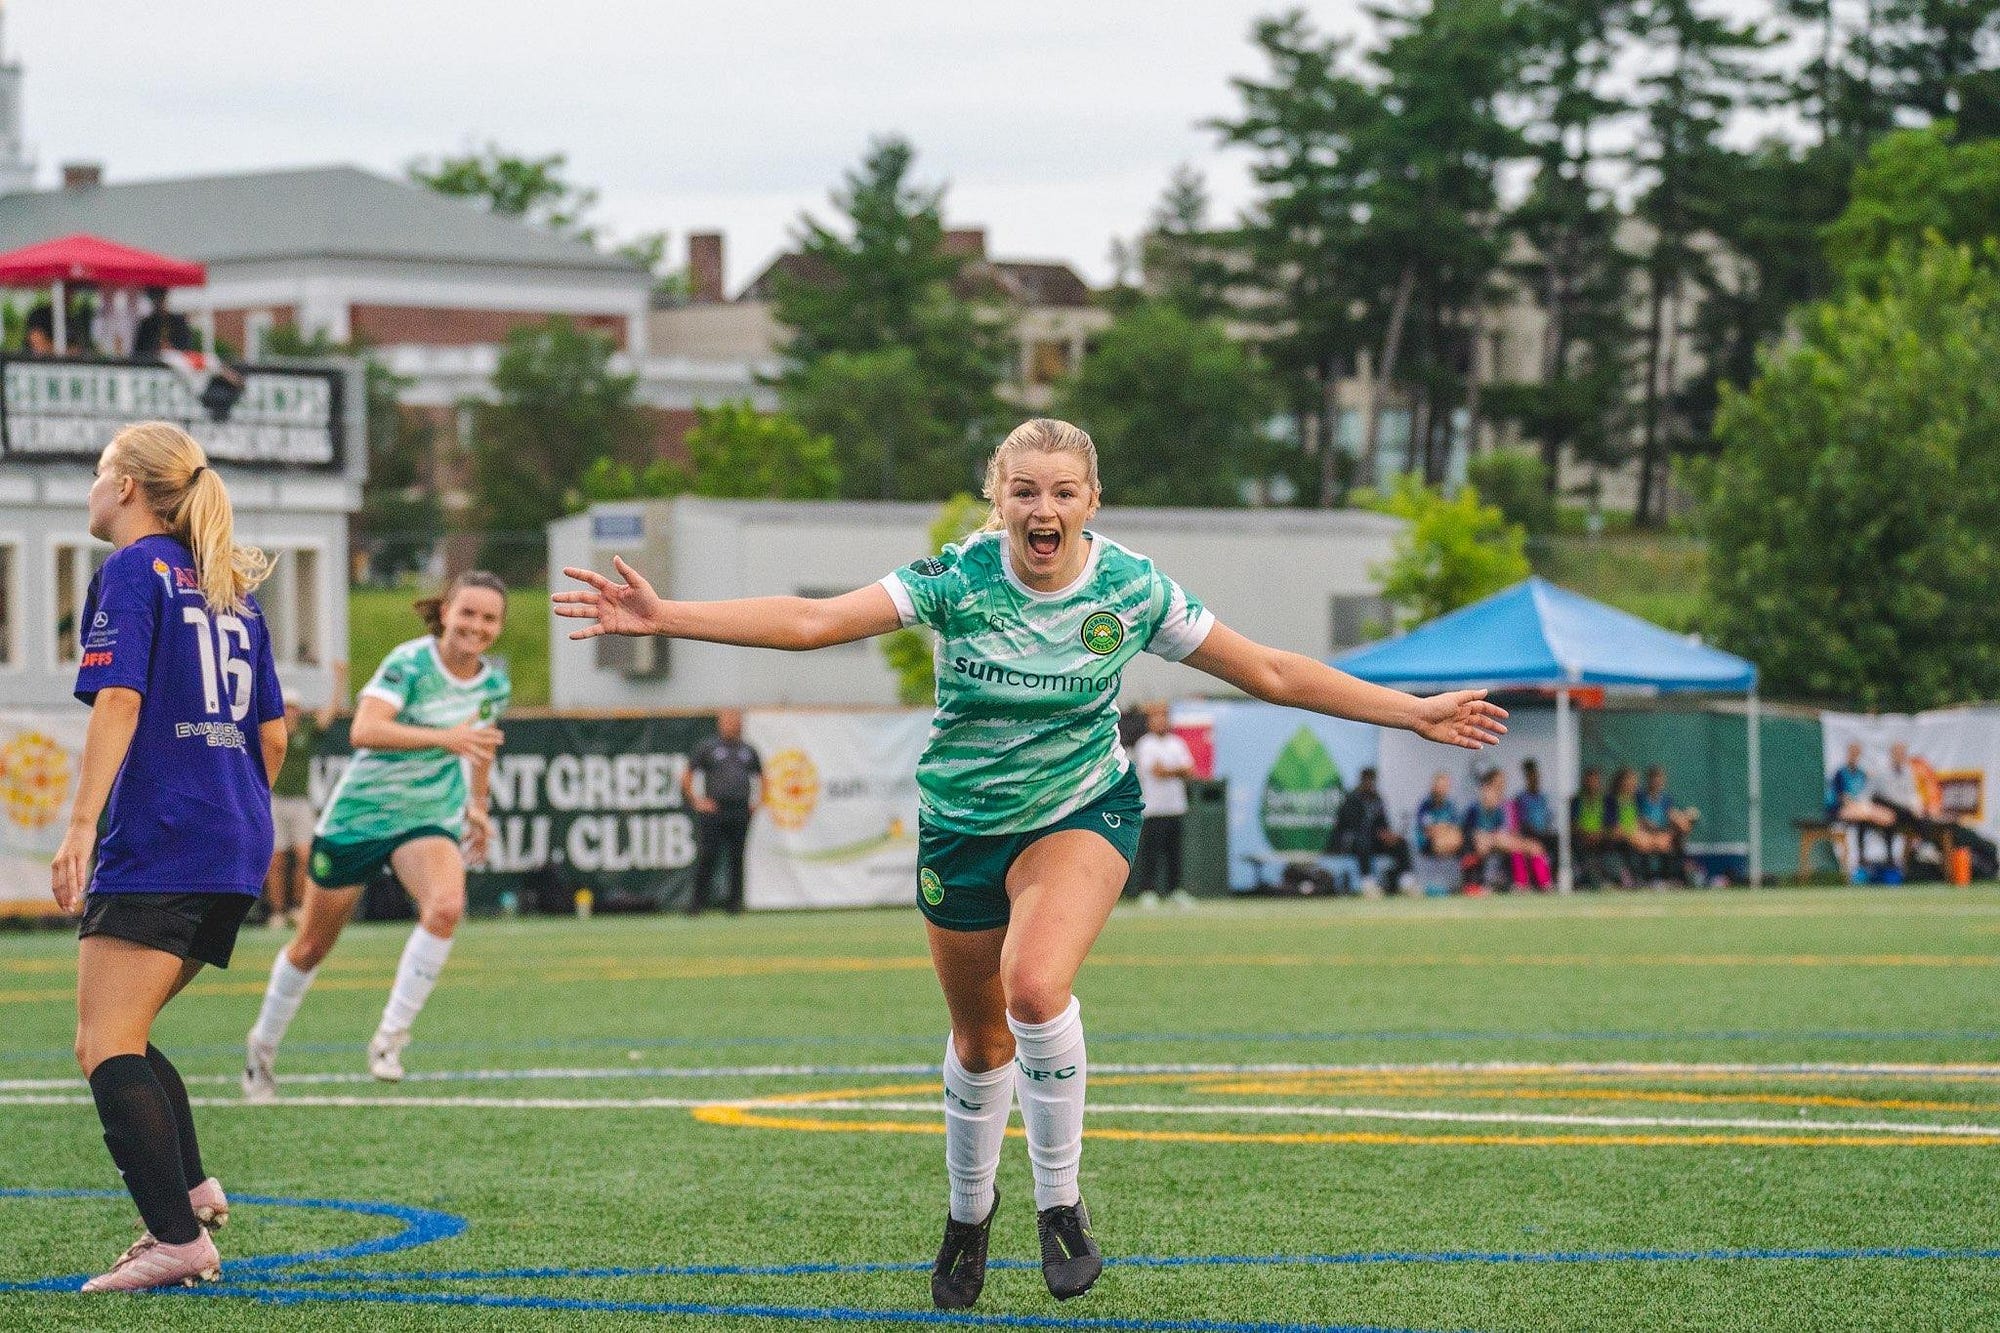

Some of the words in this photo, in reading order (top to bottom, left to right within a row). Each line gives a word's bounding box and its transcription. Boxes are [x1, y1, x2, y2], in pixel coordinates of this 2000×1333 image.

[183, 606, 253, 721] 16
[954, 655, 1119, 693] suncommon
[567, 813, 698, 871] CLUB
